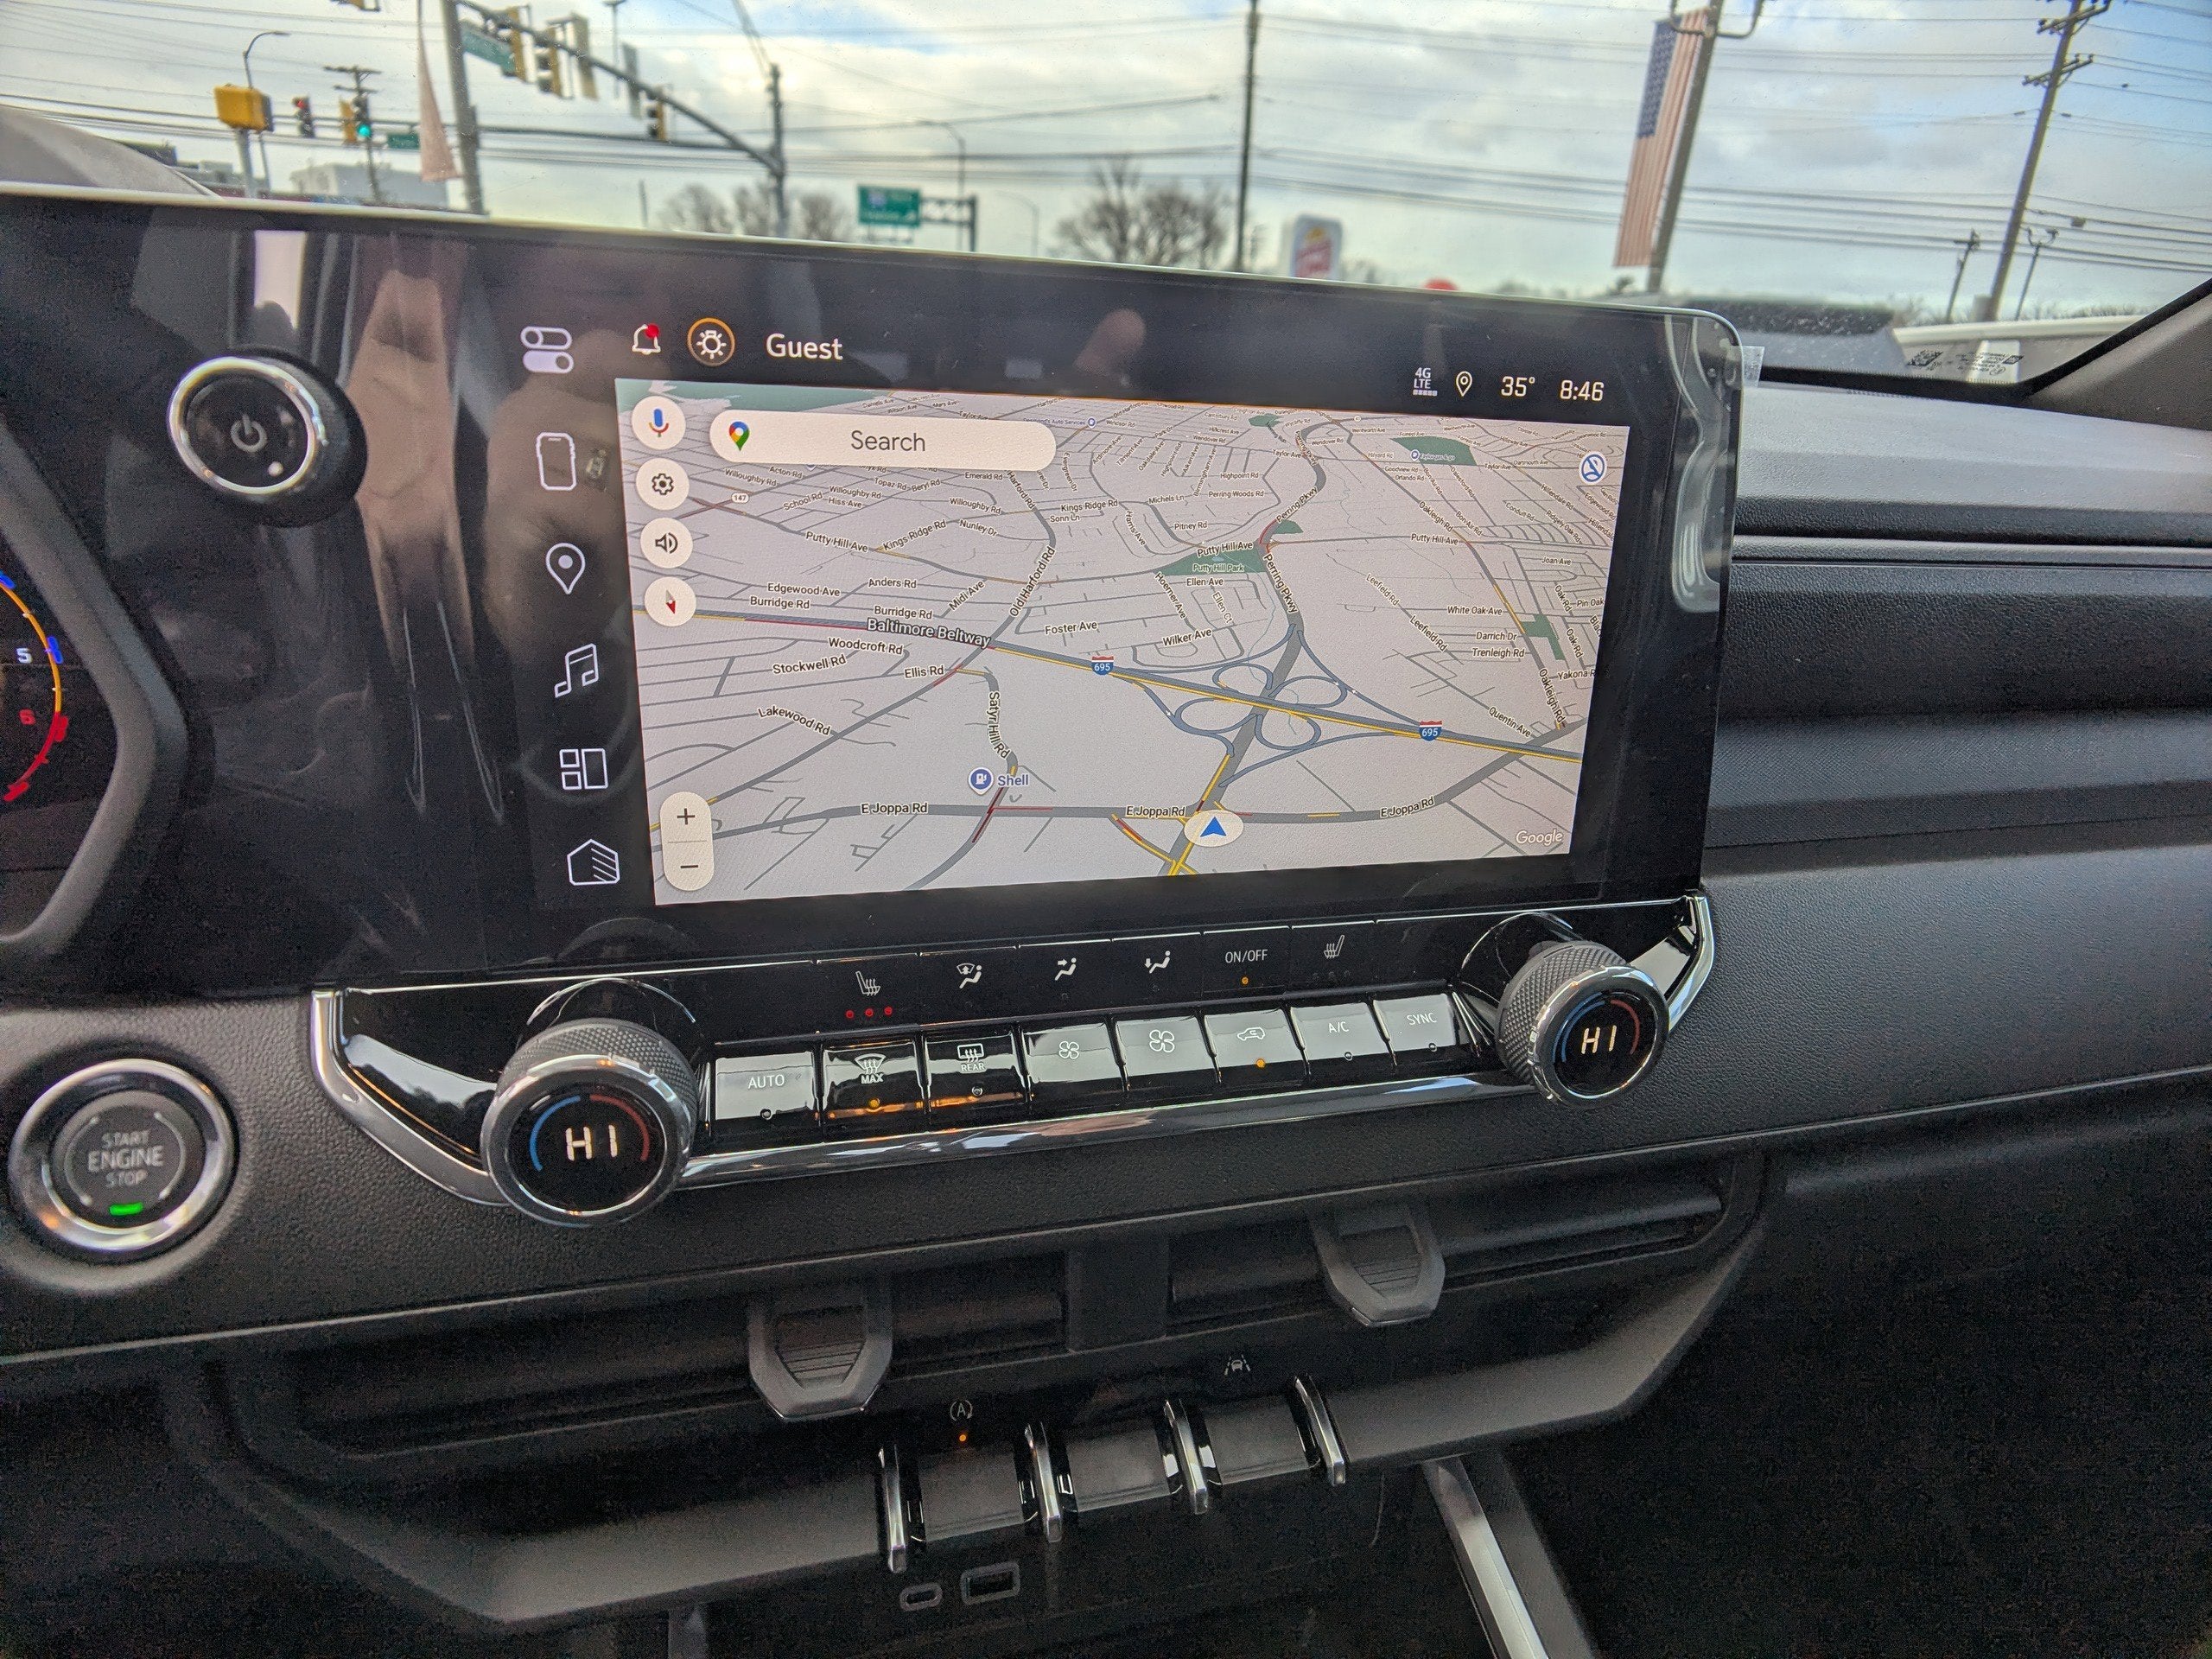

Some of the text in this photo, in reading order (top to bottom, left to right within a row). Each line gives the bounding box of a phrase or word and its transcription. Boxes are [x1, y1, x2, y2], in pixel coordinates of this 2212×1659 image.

[766, 333, 842, 360] Guest
[1414, 367, 1431, 378] 4G
[1414, 378, 1431, 389] LTE
[1501, 376, 1535, 397] 35°
[1560, 379, 1604, 401] 8:46
[851, 430, 925, 451] Search
[1139, 440, 1165, 471] Oakdale Ave
[770, 467, 791, 475] Acton
[874, 478, 895, 488] Topaz
[912, 481, 929, 492] Beryl
[830, 486, 869, 498] Willoughby
[1149, 495, 1173, 504] Michels
[784, 492, 823, 511] School Rd
[950, 499, 1001, 514] Willoughby Rd
[1084, 501, 1106, 510] Ridge
[1276, 486, 1318, 522] Perring Pkwy
[1420, 501, 1453, 531] Oakleigh Rd
[883, 520, 946, 550] Kings Ridge Rd
[960, 519, 997, 537] Nunley Dr
[806, 531, 868, 552] Putty Hill Ave
[1412, 534, 1430, 543] Putty
[1446, 537, 1459, 545] Ave
[1198, 541, 1253, 557] Putty Hill Ave
[1193, 564, 1211, 574] Putty
[768, 583, 840, 596] Edgewood Ave
[904, 580, 916, 588] Rd
[1263, 555, 1298, 613] Perring Pkwy
[751, 597, 810, 608] Burridge Rd
[1555, 585, 1572, 612] Oak Rd
[874, 606, 932, 619] Burridge Rd
[868, 619, 990, 648] Baltimore Beltway
[1045, 621, 1097, 634] Foster Ave
[1410, 616, 1446, 652] Leefield Rd
[1163, 628, 1211, 645] Wilker Ave
[1477, 632, 1504, 640] Darrich
[1567, 629, 1583, 658] Oak Rd
[829, 638, 903, 654] Woodcroft Rd
[1472, 649, 1510, 658] Trenleigh
[16, 648, 32, 664] 5
[773, 655, 846, 674] Stockwell Rd
[905, 666, 944, 677] Ellis Rd
[1540, 669, 1565, 721] Oakleigh Rd
[19, 709, 35, 724] 6
[758, 708, 830, 734] Lakewood Rd
[1489, 708, 1531, 737] Quentin Ave
[988, 692, 1010, 758] Satyr Hill Rd
[998, 776, 1028, 785] Shell
[861, 804, 927, 815] E Joppa Rd
[1127, 806, 1185, 817] E Joppa Rd
[1390, 804, 1420, 817] Joppa
[1421, 797, 1433, 807] Rd
[1516, 830, 1562, 846] Google
[1225, 950, 1268, 963] ON/OFF
[1407, 1013, 1437, 1025] SYNC
[1329, 1022, 1349, 1033] A/C
[962, 1062, 984, 1072] REAR
[748, 1075, 785, 1089] AUTO
[861, 1074, 884, 1084] MAX
[102, 1131, 150, 1149] START
[88, 1146, 164, 1172] ENGINE
[105, 1169, 148, 1188] STOP
